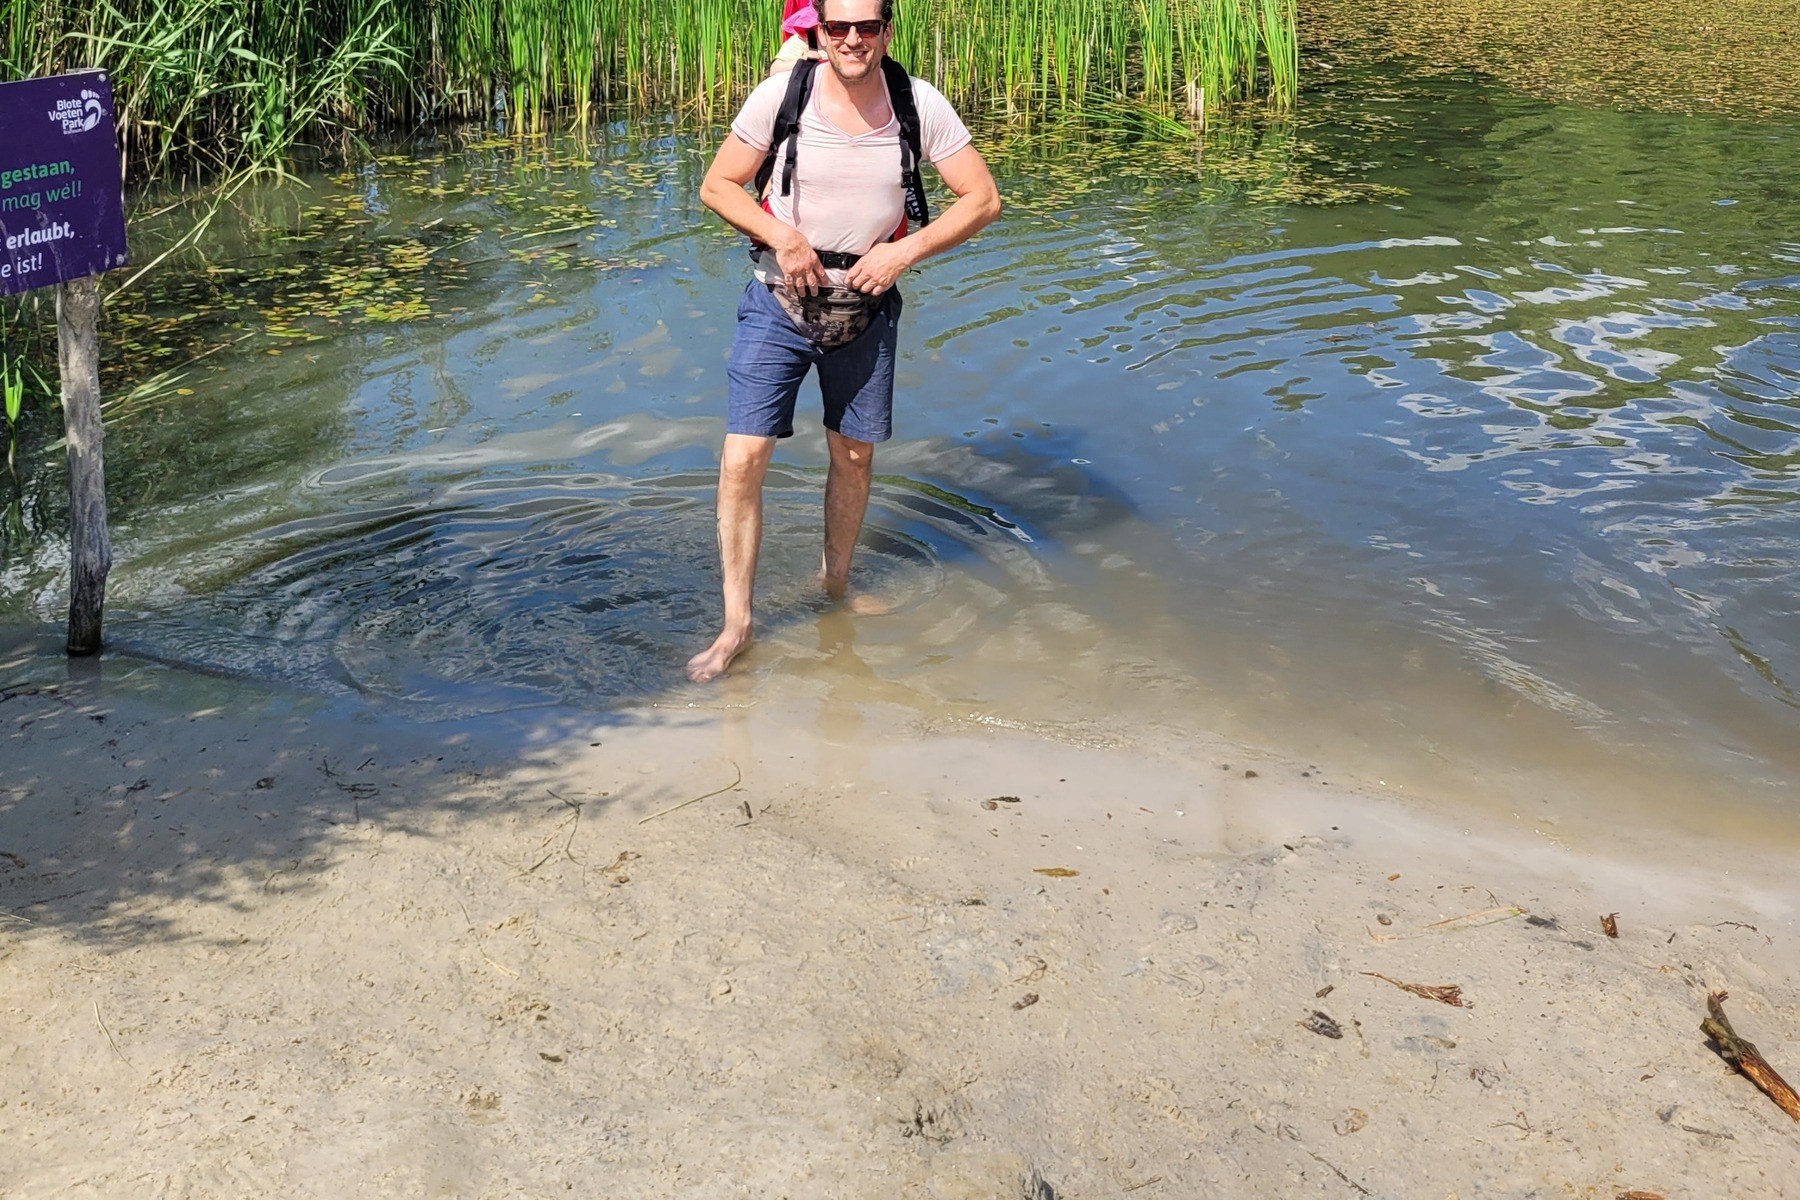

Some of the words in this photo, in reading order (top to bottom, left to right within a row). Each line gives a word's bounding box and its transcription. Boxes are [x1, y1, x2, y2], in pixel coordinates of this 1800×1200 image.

[56, 99, 82, 111] Blote
[48, 108, 83, 121] Voeten
[62, 118, 85, 130] Park
[2, 191, 41, 210] mag
[6, 221, 75, 250] erlaubt,
[17, 252, 42, 274] ist!
